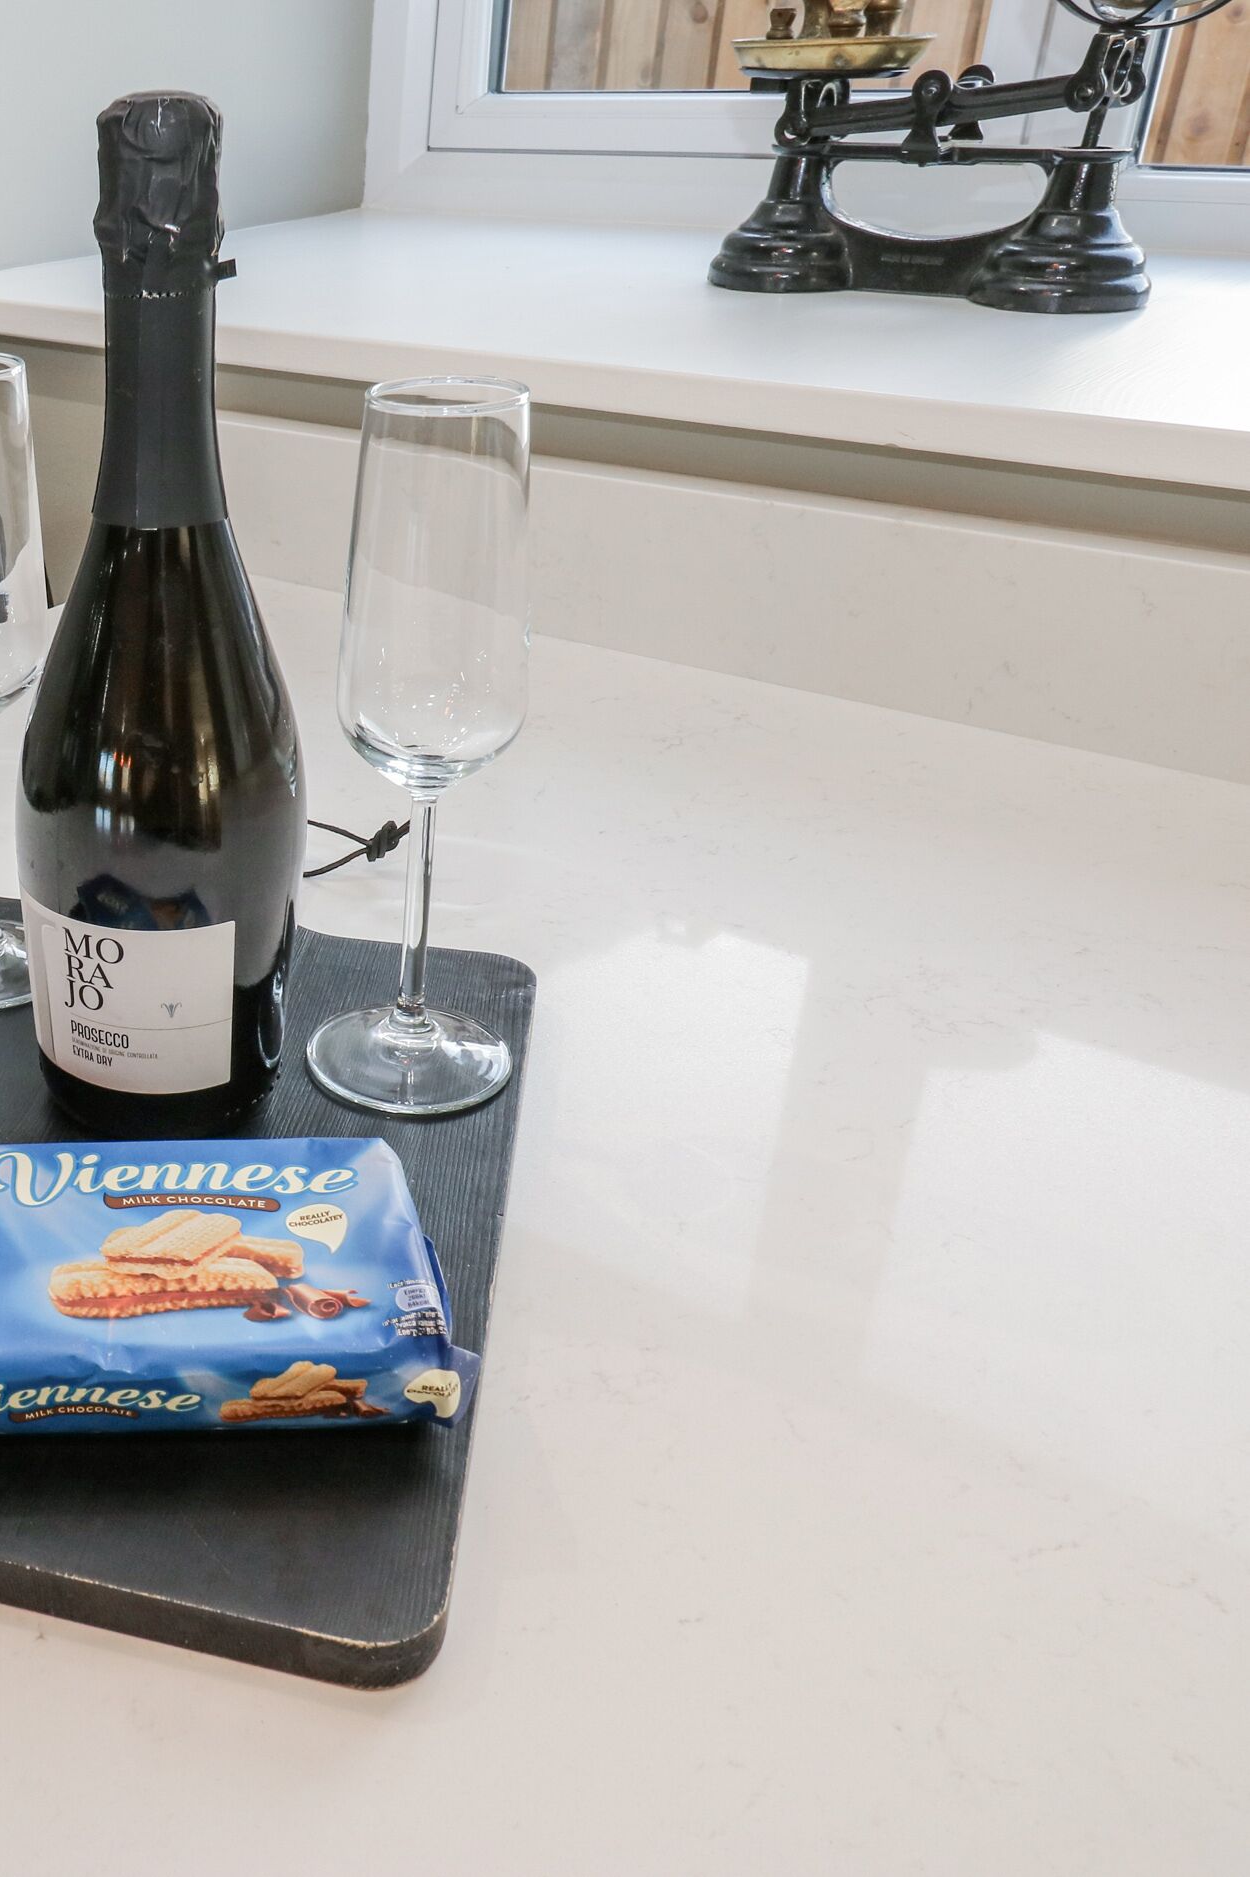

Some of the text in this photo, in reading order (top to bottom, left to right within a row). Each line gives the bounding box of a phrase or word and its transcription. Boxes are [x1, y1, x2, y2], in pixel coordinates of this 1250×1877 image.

[62, 927, 124, 964] MO
[64, 951, 114, 989] RA
[64, 977, 104, 1010] JO
[71, 1019, 129, 1049] PROSECCO
[72, 1044, 113, 1067] EXTRA DRY
[122, 1194, 266, 1209] MILK CHOCOLATE
[288, 1213, 344, 1228] CHOCOLATEY
[299, 1210, 331, 1222] REALLY
[25, 1405, 132, 1420] MILK CHOCOLATE
